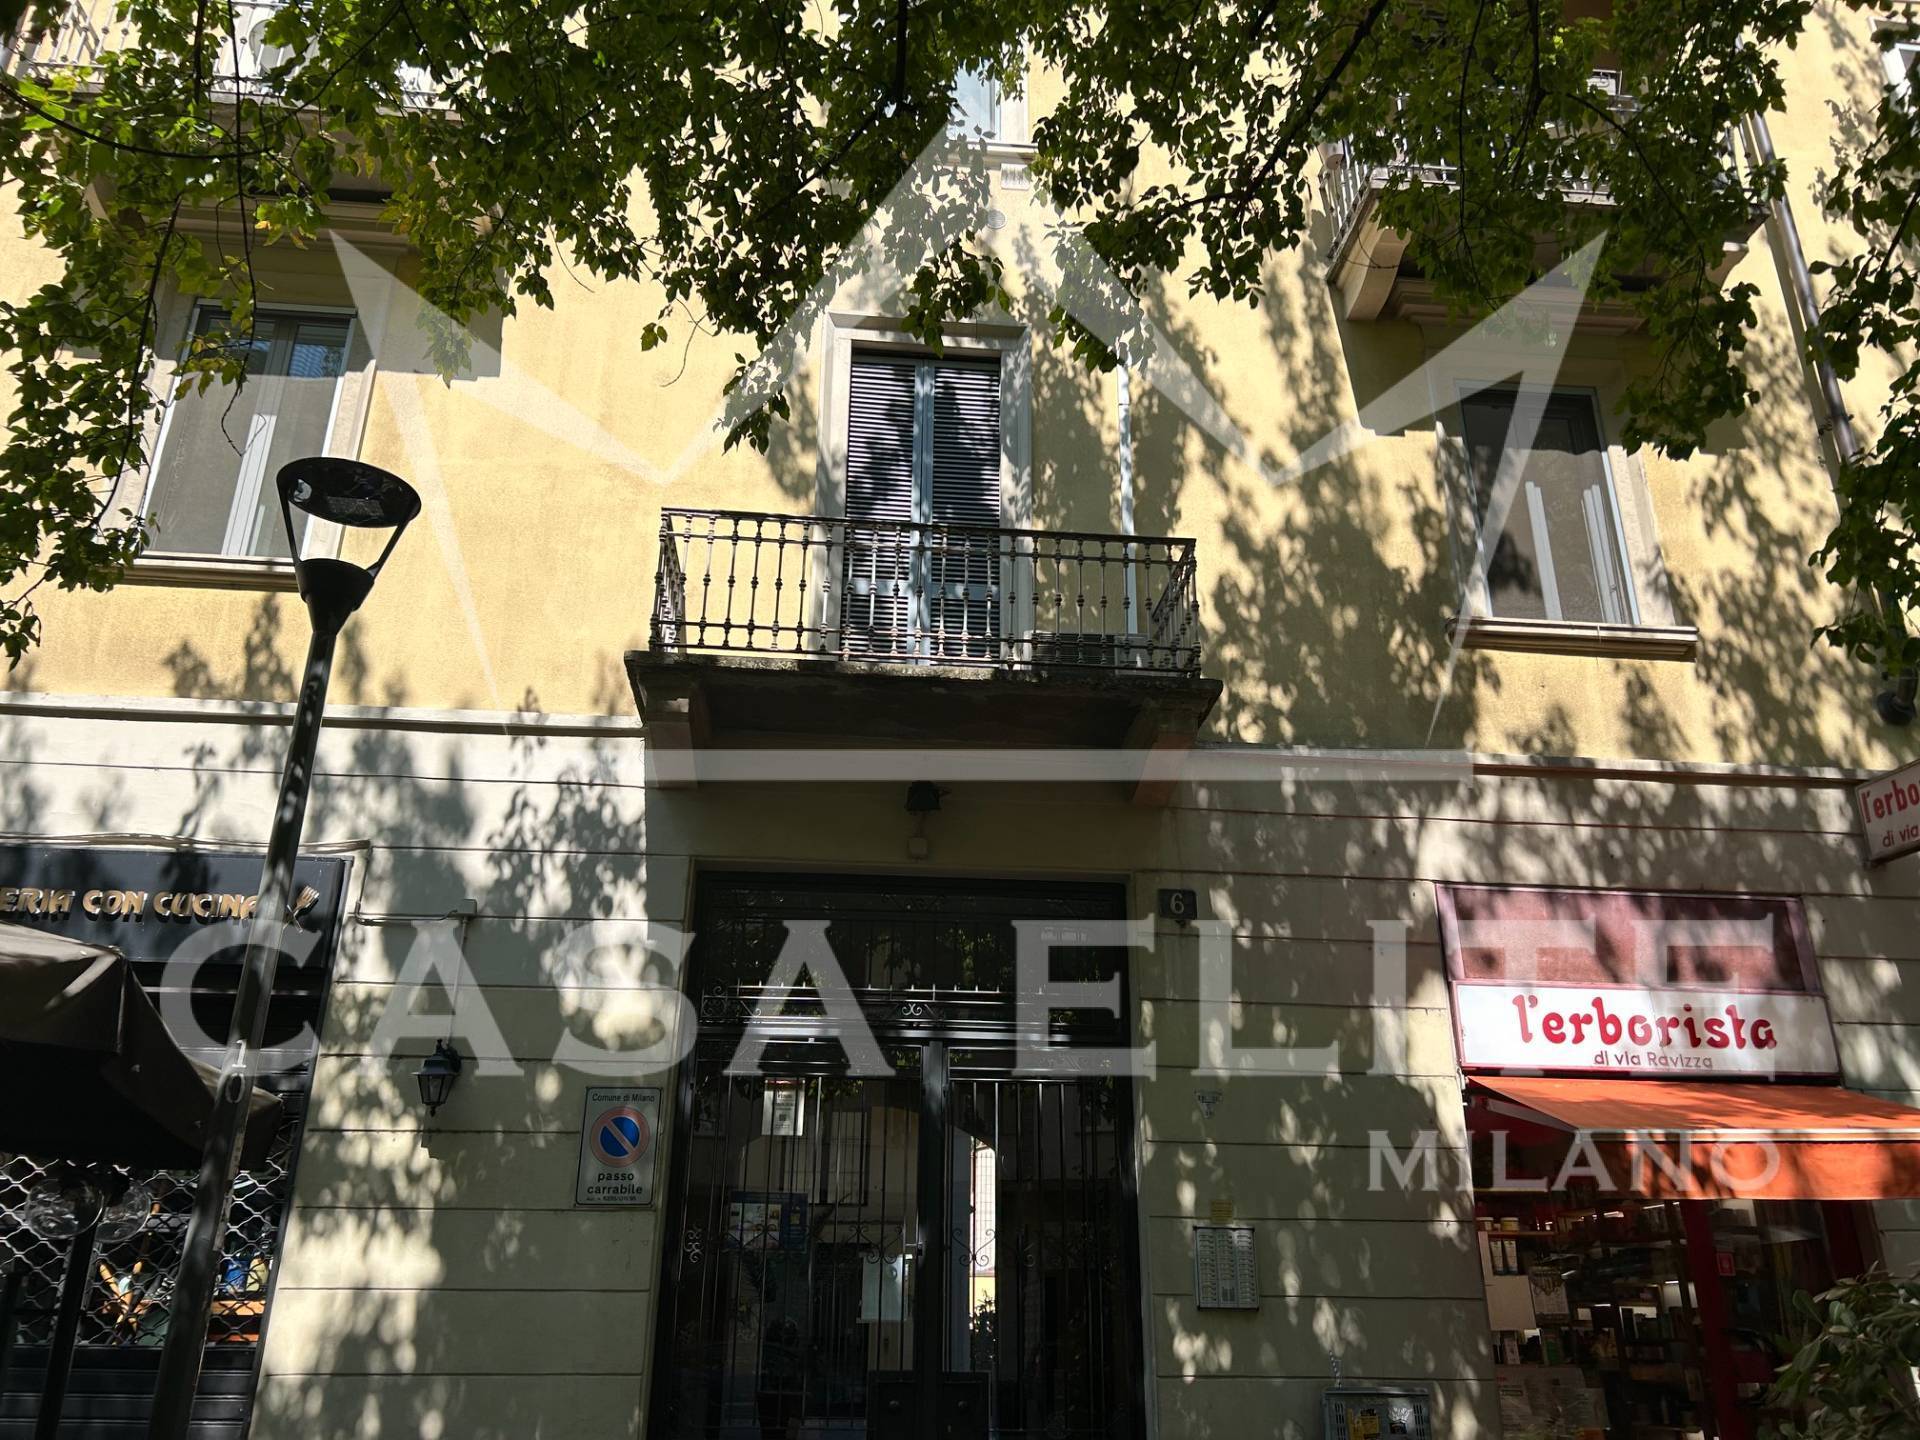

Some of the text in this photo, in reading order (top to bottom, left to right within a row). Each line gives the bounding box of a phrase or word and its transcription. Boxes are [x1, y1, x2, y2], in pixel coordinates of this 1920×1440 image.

[1861, 780, 1920, 823] l'erbo
[1882, 824, 1919, 847] di via
[83, 889, 148, 915] CON
[1170, 893, 1184, 914] 6
[1512, 994, 1777, 1050] l'erborista
[1594, 1051, 1713, 1069] di via Ravizza
[592, 1093, 655, 1102] Comune di Milano
[598, 1172, 634, 1182] passo
[587, 1183, 643, 1194] carrabile
